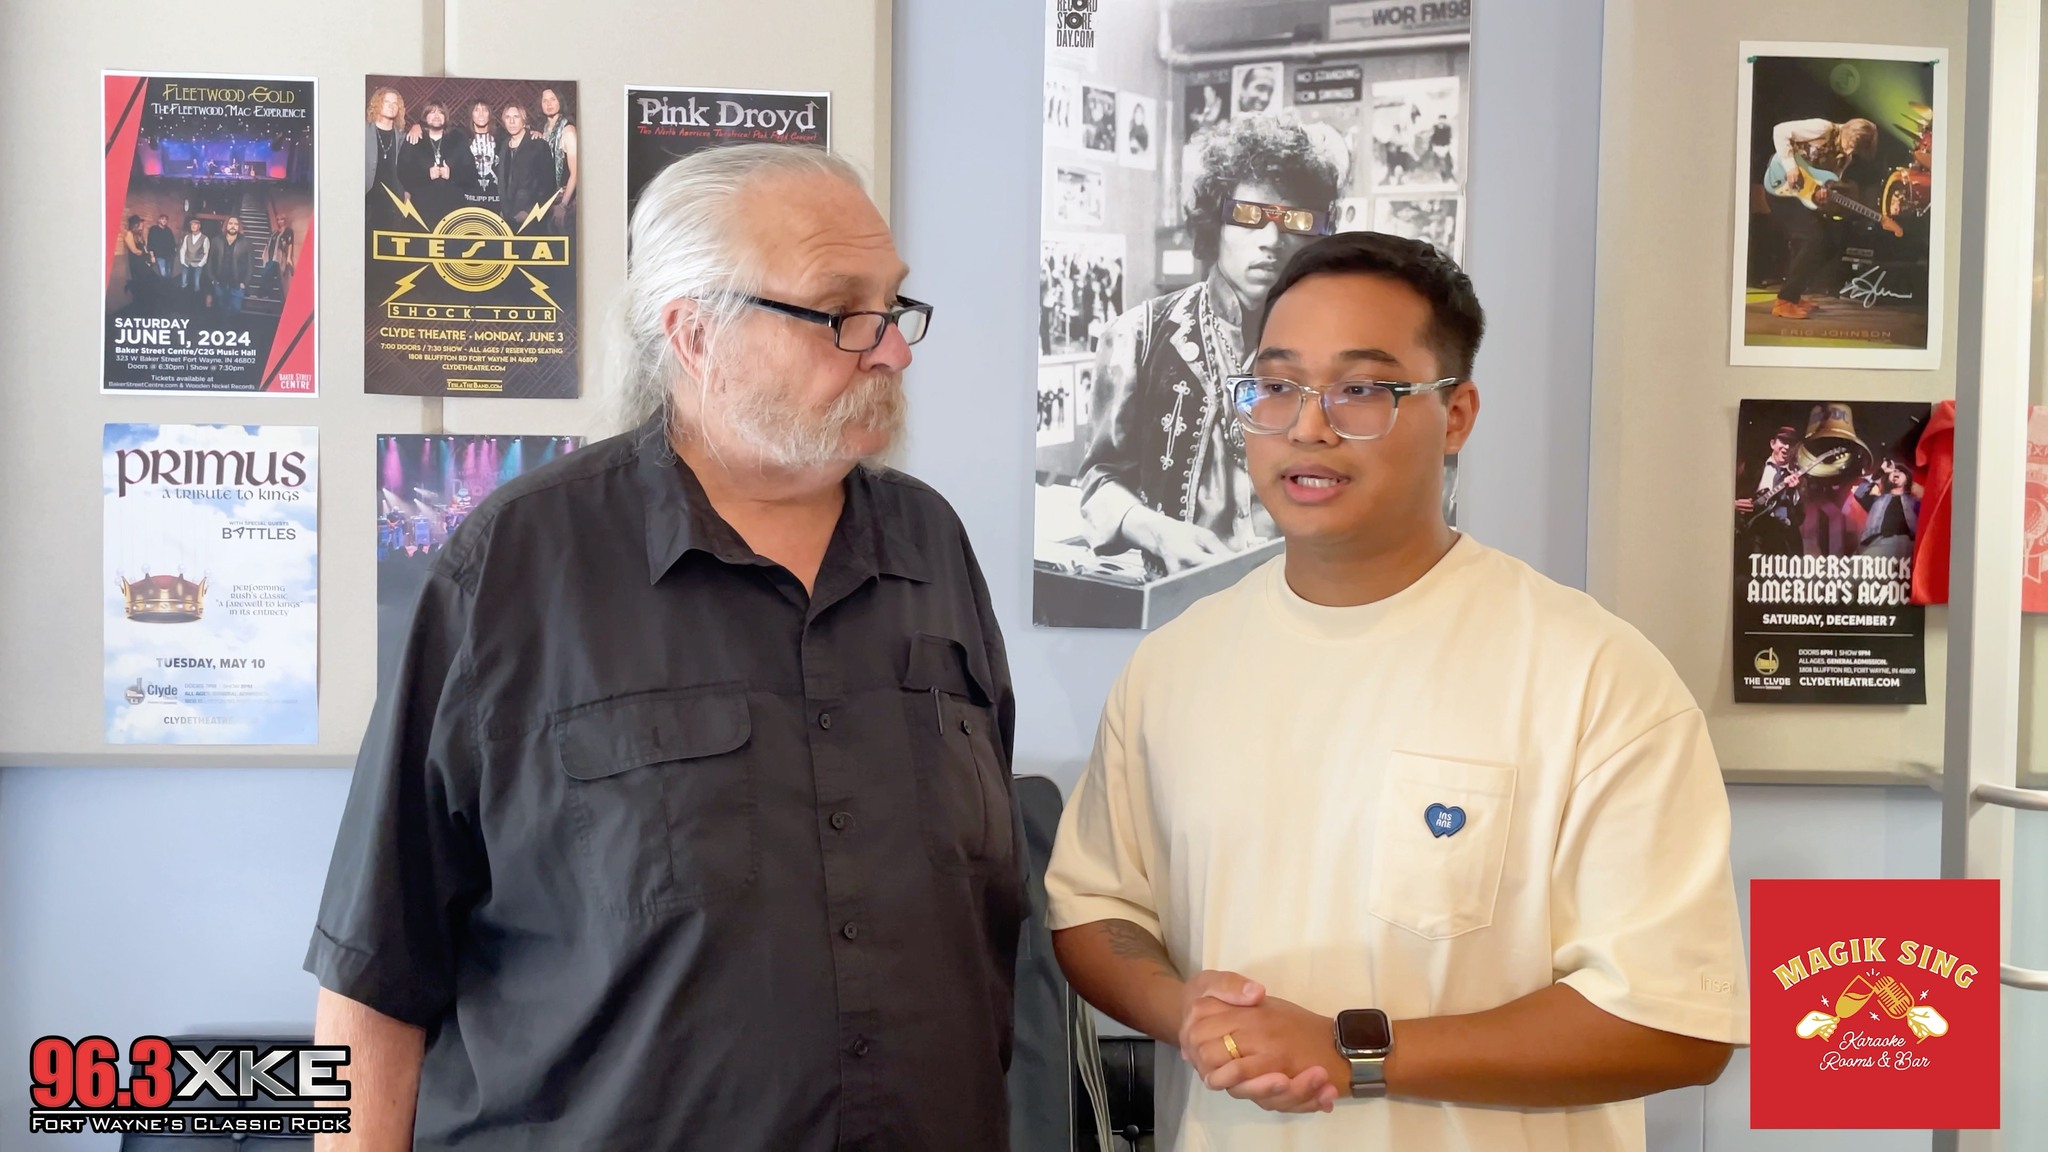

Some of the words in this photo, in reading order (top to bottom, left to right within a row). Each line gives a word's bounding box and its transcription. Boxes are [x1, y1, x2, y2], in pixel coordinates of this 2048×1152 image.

[1057, 12, 1092, 30] STORE
[1373, 6, 1416, 25] WOR
[1057, 30, 1094, 48] DAY.COM
[163, 84, 245, 102] FLEETWOOD
[248, 86, 294, 103] GOLD
[151, 103, 169, 114] THE
[170, 104, 224, 116] FLEETWOOD
[225, 105, 251, 117] MAC
[254, 106, 306, 118] EXPERIENCE
[637, 97, 709, 127] Pink
[716, 100, 819, 135] Droyd
[391, 237, 553, 260] TESLA
[392, 306, 472, 319] SHOCK
[494, 310, 552, 320] TOUR
[115, 318, 189, 329] SATURDAY
[115, 329, 171, 345] JUNE
[178, 330, 192, 348] 1,
[198, 331, 251, 346] 2024
[380, 327, 415, 338] CLYDE
[418, 329, 466, 340] THEATRE
[475, 331, 524, 342] MONDAY,
[527, 332, 555, 342] JUNE
[558, 332, 564, 342] 3
[1821, 330, 1891, 338] JOHNSON
[168, 348, 214, 356] Centre/C2G
[442, 364, 506, 372] CLYDETHEATRE.COM
[281, 380, 310, 389] CENTRE
[296, 373, 311, 382] STREET
[1749, 554, 1911, 580] THUNDERSTRUCK
[1747, 580, 1852, 605] AMERICA'S
[1763, 614, 1824, 628] SATURDAY,
[1827, 615, 1886, 626] DECEMBER
[1889, 616, 1896, 626] 7
[156, 658, 216, 669] TUESDAY,
[220, 658, 247, 668] MAY
[251, 658, 266, 669] 10
[1744, 677, 1760, 685] THE
[1764, 677, 1791, 685] CLYDE
[1800, 677, 1900, 687] CLYDETHEATRE.COM
[147, 684, 178, 698] Clyde
